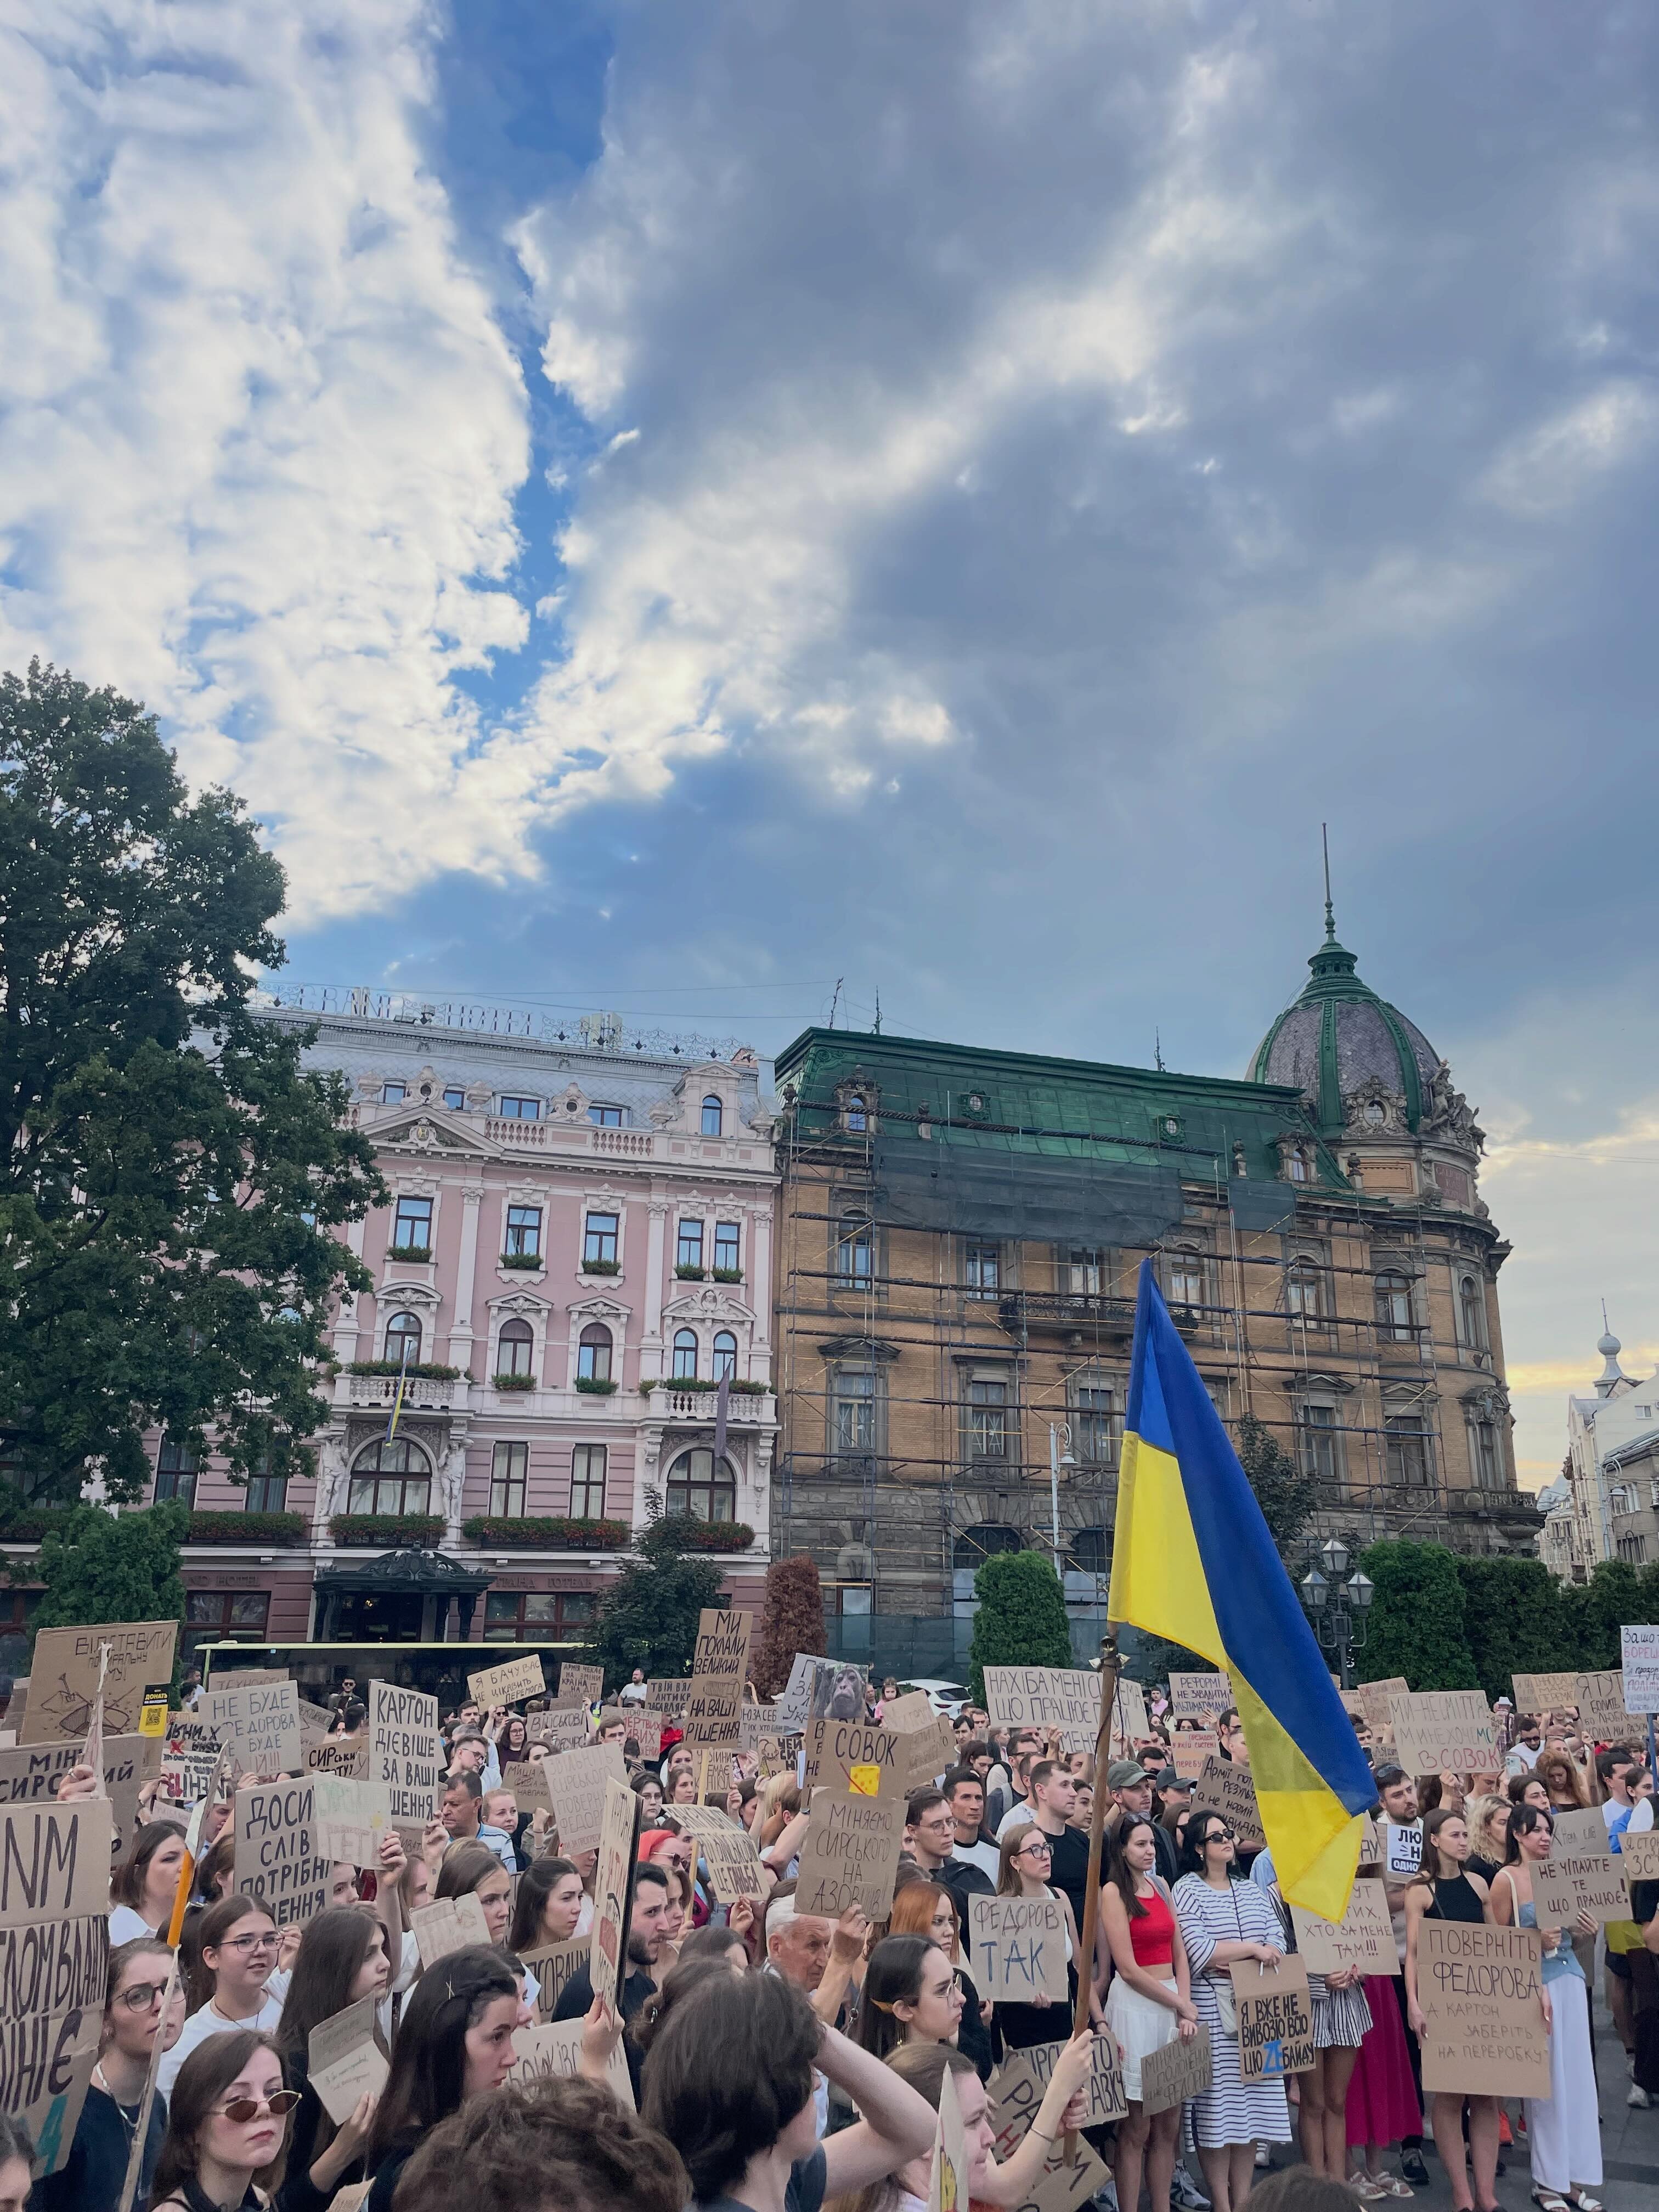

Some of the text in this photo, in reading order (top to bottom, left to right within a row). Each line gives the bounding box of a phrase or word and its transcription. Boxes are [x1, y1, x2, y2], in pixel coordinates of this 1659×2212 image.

[715, 1611, 742, 1634] МИ
[698, 1635, 746, 1656] ПОКЛАЛИ
[476, 1660, 540, 1690] Я БАЧУ ВАС
[695, 1657, 739, 1674] ВЕЛИКИЙ
[475, 1678, 532, 1702] НЕ ЦІКАВИТЬ
[505, 1683, 543, 1703] ПЕРЕМОГА
[651, 1681, 673, 1693] ТВІЙ
[655, 1693, 691, 1702] АНТИКР
[1050, 1672, 1087, 1697] МЕНІ
[1088, 1675, 1145, 1711] СЕМА
[1177, 1690, 1189, 1699] НЕ
[1576, 1672, 1623, 1700] Я ТУТ
[213, 1689, 290, 1719] НЕ БУДЕ
[377, 1689, 433, 1728] КАРТОН
[690, 1700, 706, 1717] НА
[763, 1708, 777, 1722] СЕБ
[995, 1697, 1024, 1722] ЩО
[1030, 1697, 1092, 1724] ПРАЦЮЄ
[249, 1734, 281, 1752] БУДЕ
[375, 1728, 435, 1757] ДІЄВІШЕ
[686, 1722, 740, 1741] РІШЕННЯ
[834, 1728, 899, 1768] СОВОК
[1440, 1746, 1499, 1769] СОВОК
[0, 1759, 134, 1803] СИРСИЙ
[382, 1757, 399, 1784] ЗА
[406, 1761, 435, 1786] ВАШІ
[246, 1785, 315, 1839] ДОСИ
[390, 1788, 433, 1821] ШЕННЯ
[829, 1803, 893, 1831] МІНЯЄМО
[261, 1829, 310, 1867] СЛІВ
[816, 1830, 891, 1863] СИРСЬКОГО
[1398, 1829, 1422, 1844] ЛЮ
[240, 1855, 330, 1898] ПОТРІБНІ
[843, 1862, 863, 1884] НА
[1393, 1859, 1419, 1872] ОДНО
[1539, 1858, 1610, 1880] НЕ ЧІПАЙТЕ
[1353, 1886, 1372, 1898] УТ
[1572, 1878, 1588, 1892] ТЕ
[273, 1888, 325, 1926] ЕННЯ
[974, 1900, 1059, 1937] ФЕДОРОВ
[1548, 1898, 1570, 1915] ЩО
[1303, 1924, 1392, 1938] ХТО ЗА МЕНЕ
[1429, 1929, 1537, 1962] ПОВЕРНІТЬ
[979, 1937, 1047, 1985] ТАК
[1433, 1961, 1541, 2001] ФЕДОРОВА
[1241, 1993, 1299, 2027] Я ВЖЕ НЕ
[1426, 2002, 1499, 2018] А КАРТОН
[1242, 2014, 1308, 2048] ВИВОЗЮ ВСЮ
[1463, 2024, 1533, 2040] ЗАБЕРІТЬ
[1243, 2049, 1262, 2076] ЦЮ
[1438, 2045, 1543, 2064] НА ПЕРЕРОБКУ
